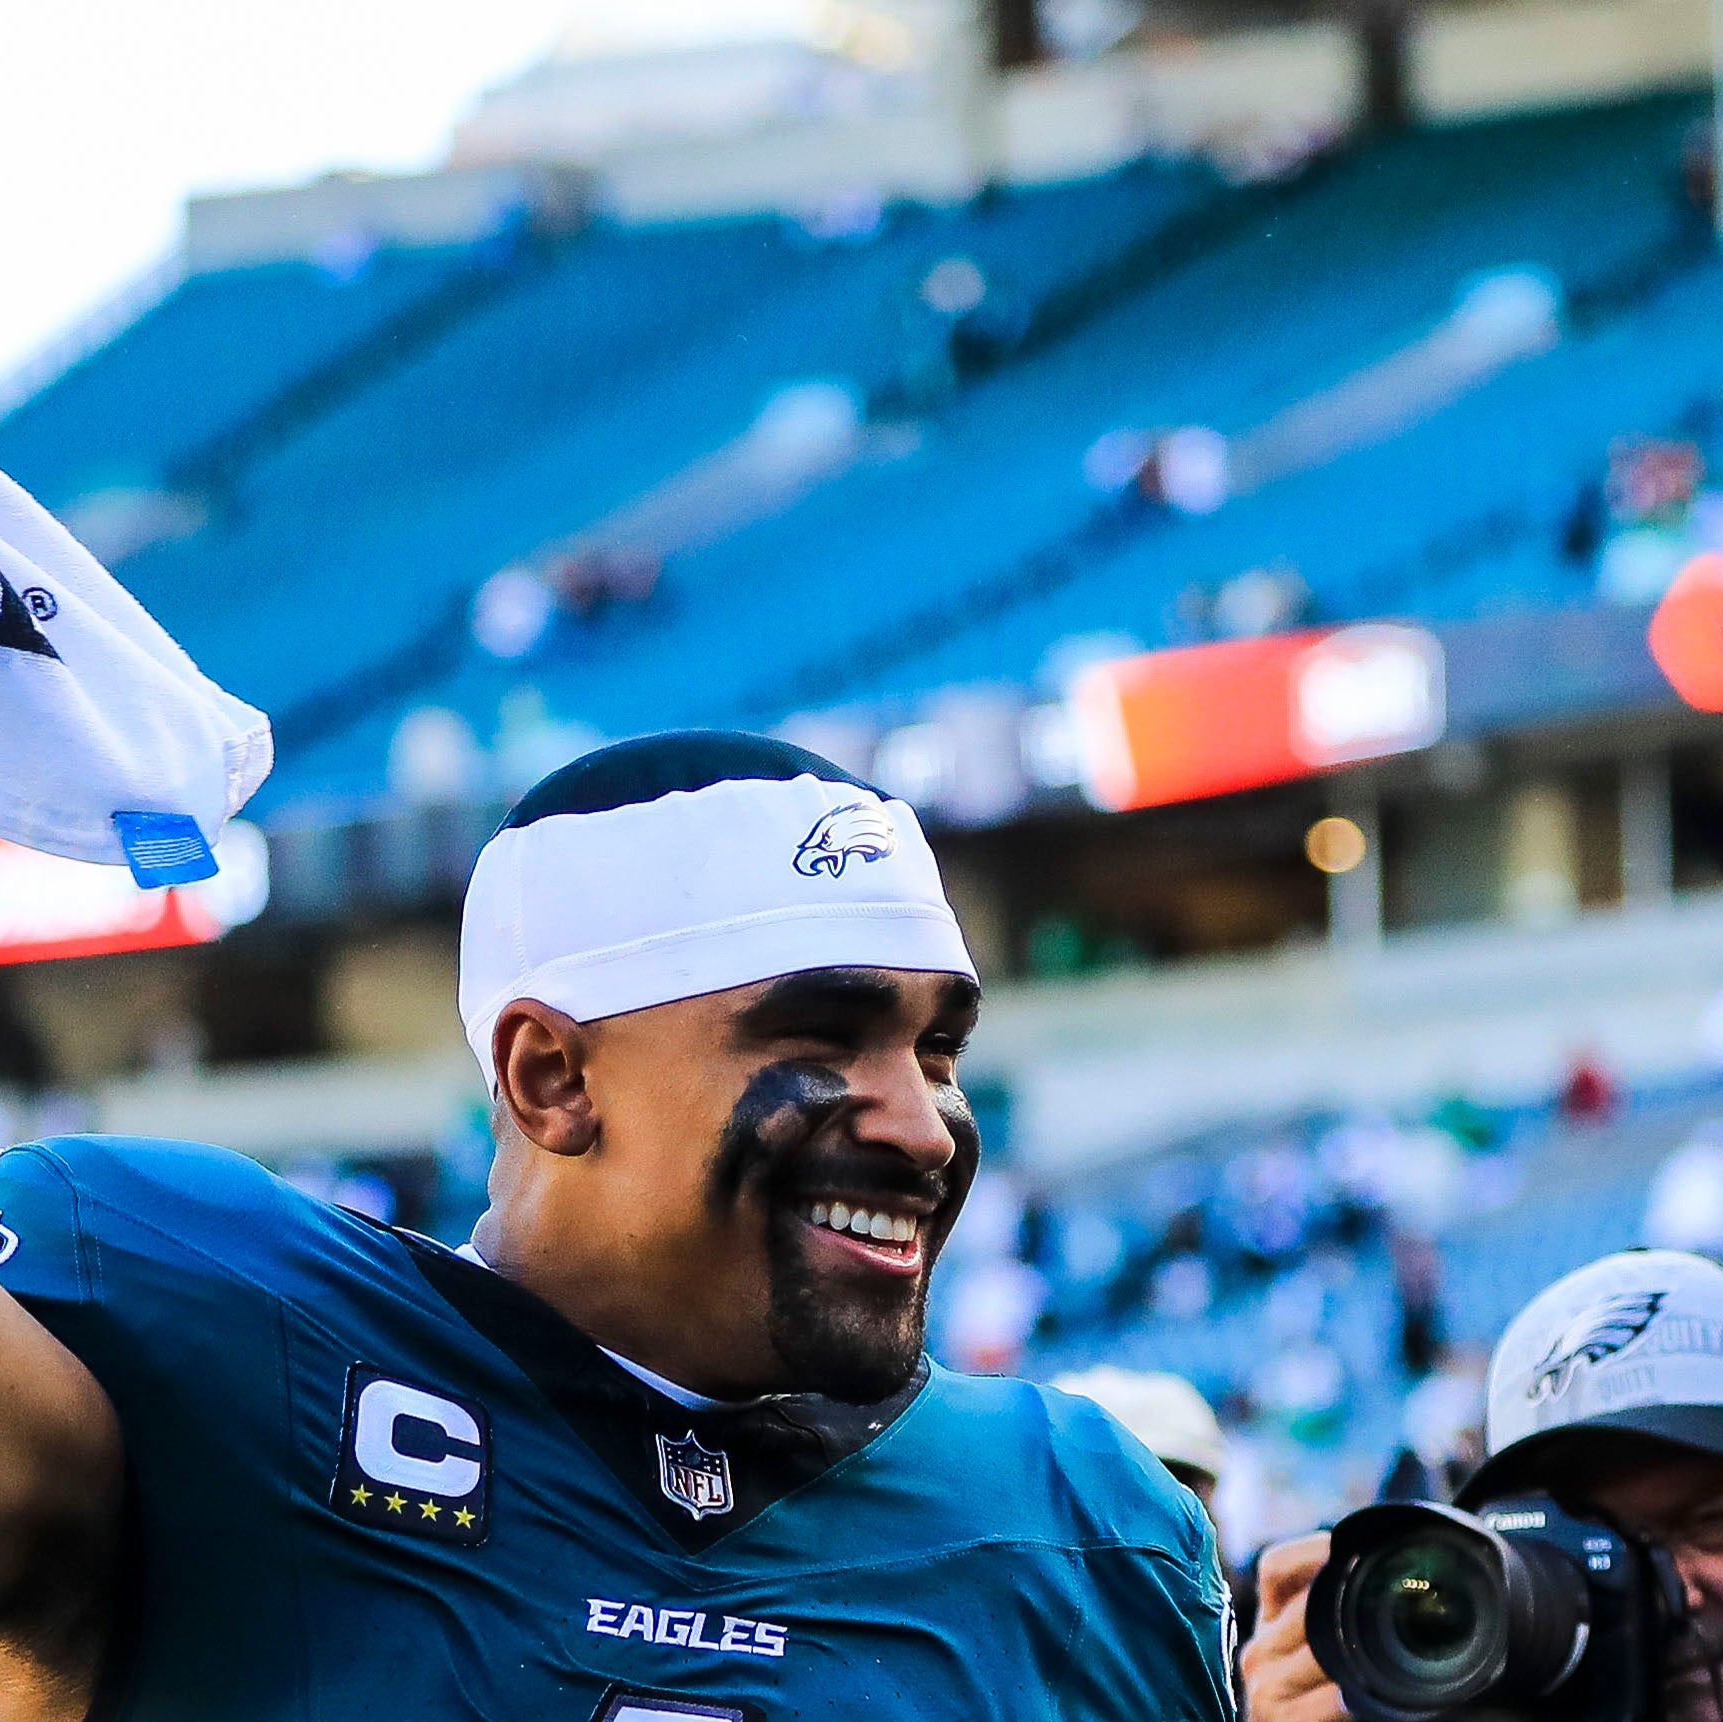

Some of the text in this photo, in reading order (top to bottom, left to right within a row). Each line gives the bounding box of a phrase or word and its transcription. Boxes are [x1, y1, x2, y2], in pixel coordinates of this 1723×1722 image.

[355, 1379, 481, 1498] C
[667, 1464, 724, 1505] NFL
[586, 1598, 789, 1657] EAGLES
